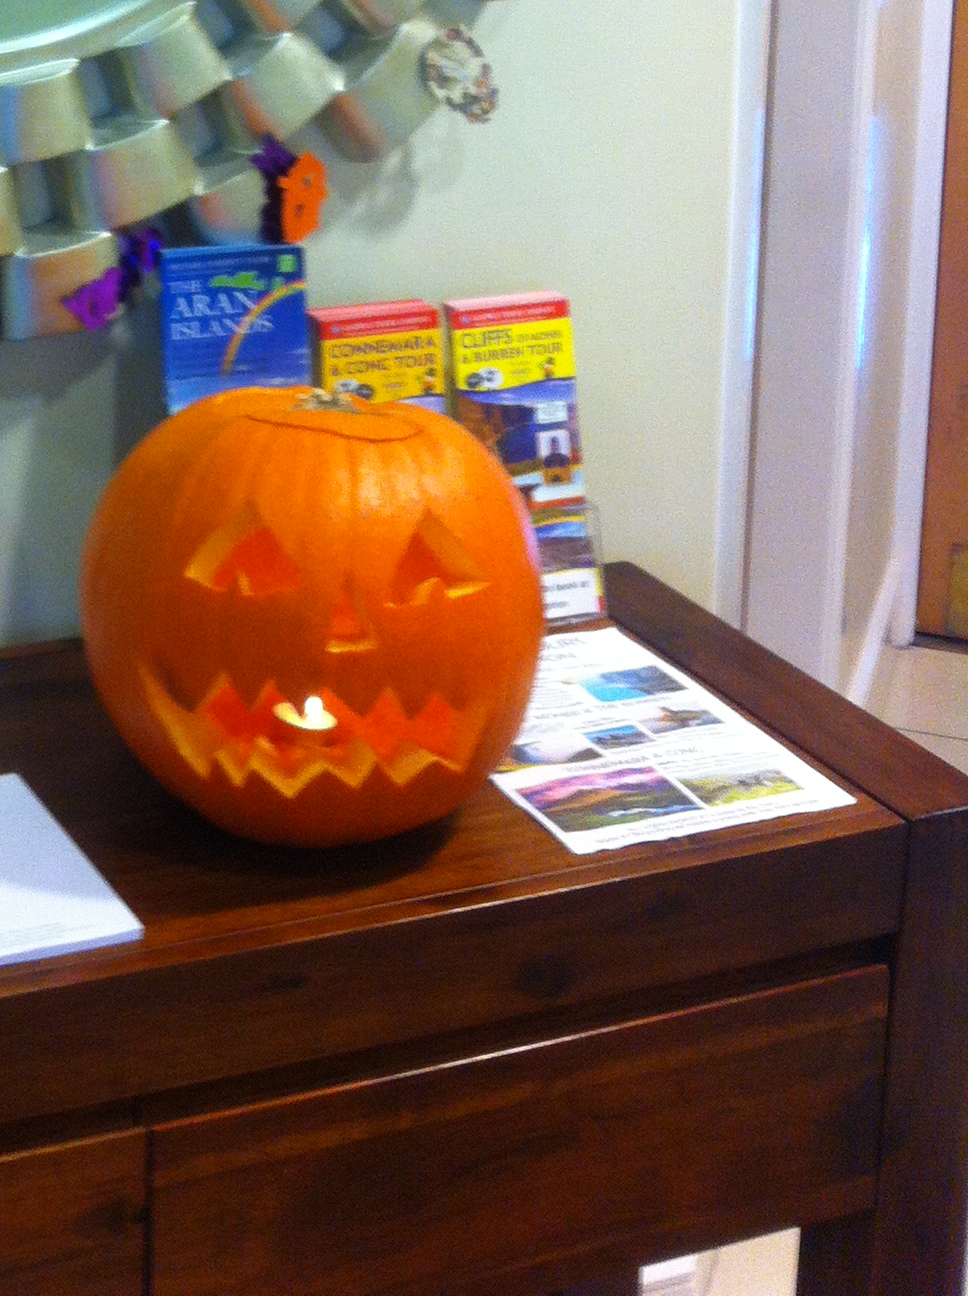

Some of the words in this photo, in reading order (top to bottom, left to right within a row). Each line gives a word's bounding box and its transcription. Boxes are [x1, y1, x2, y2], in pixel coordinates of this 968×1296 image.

[170, 289, 259, 319] ARAN
[461, 328, 513, 349] CLIFFS
[526, 341, 563, 356] TOUR
